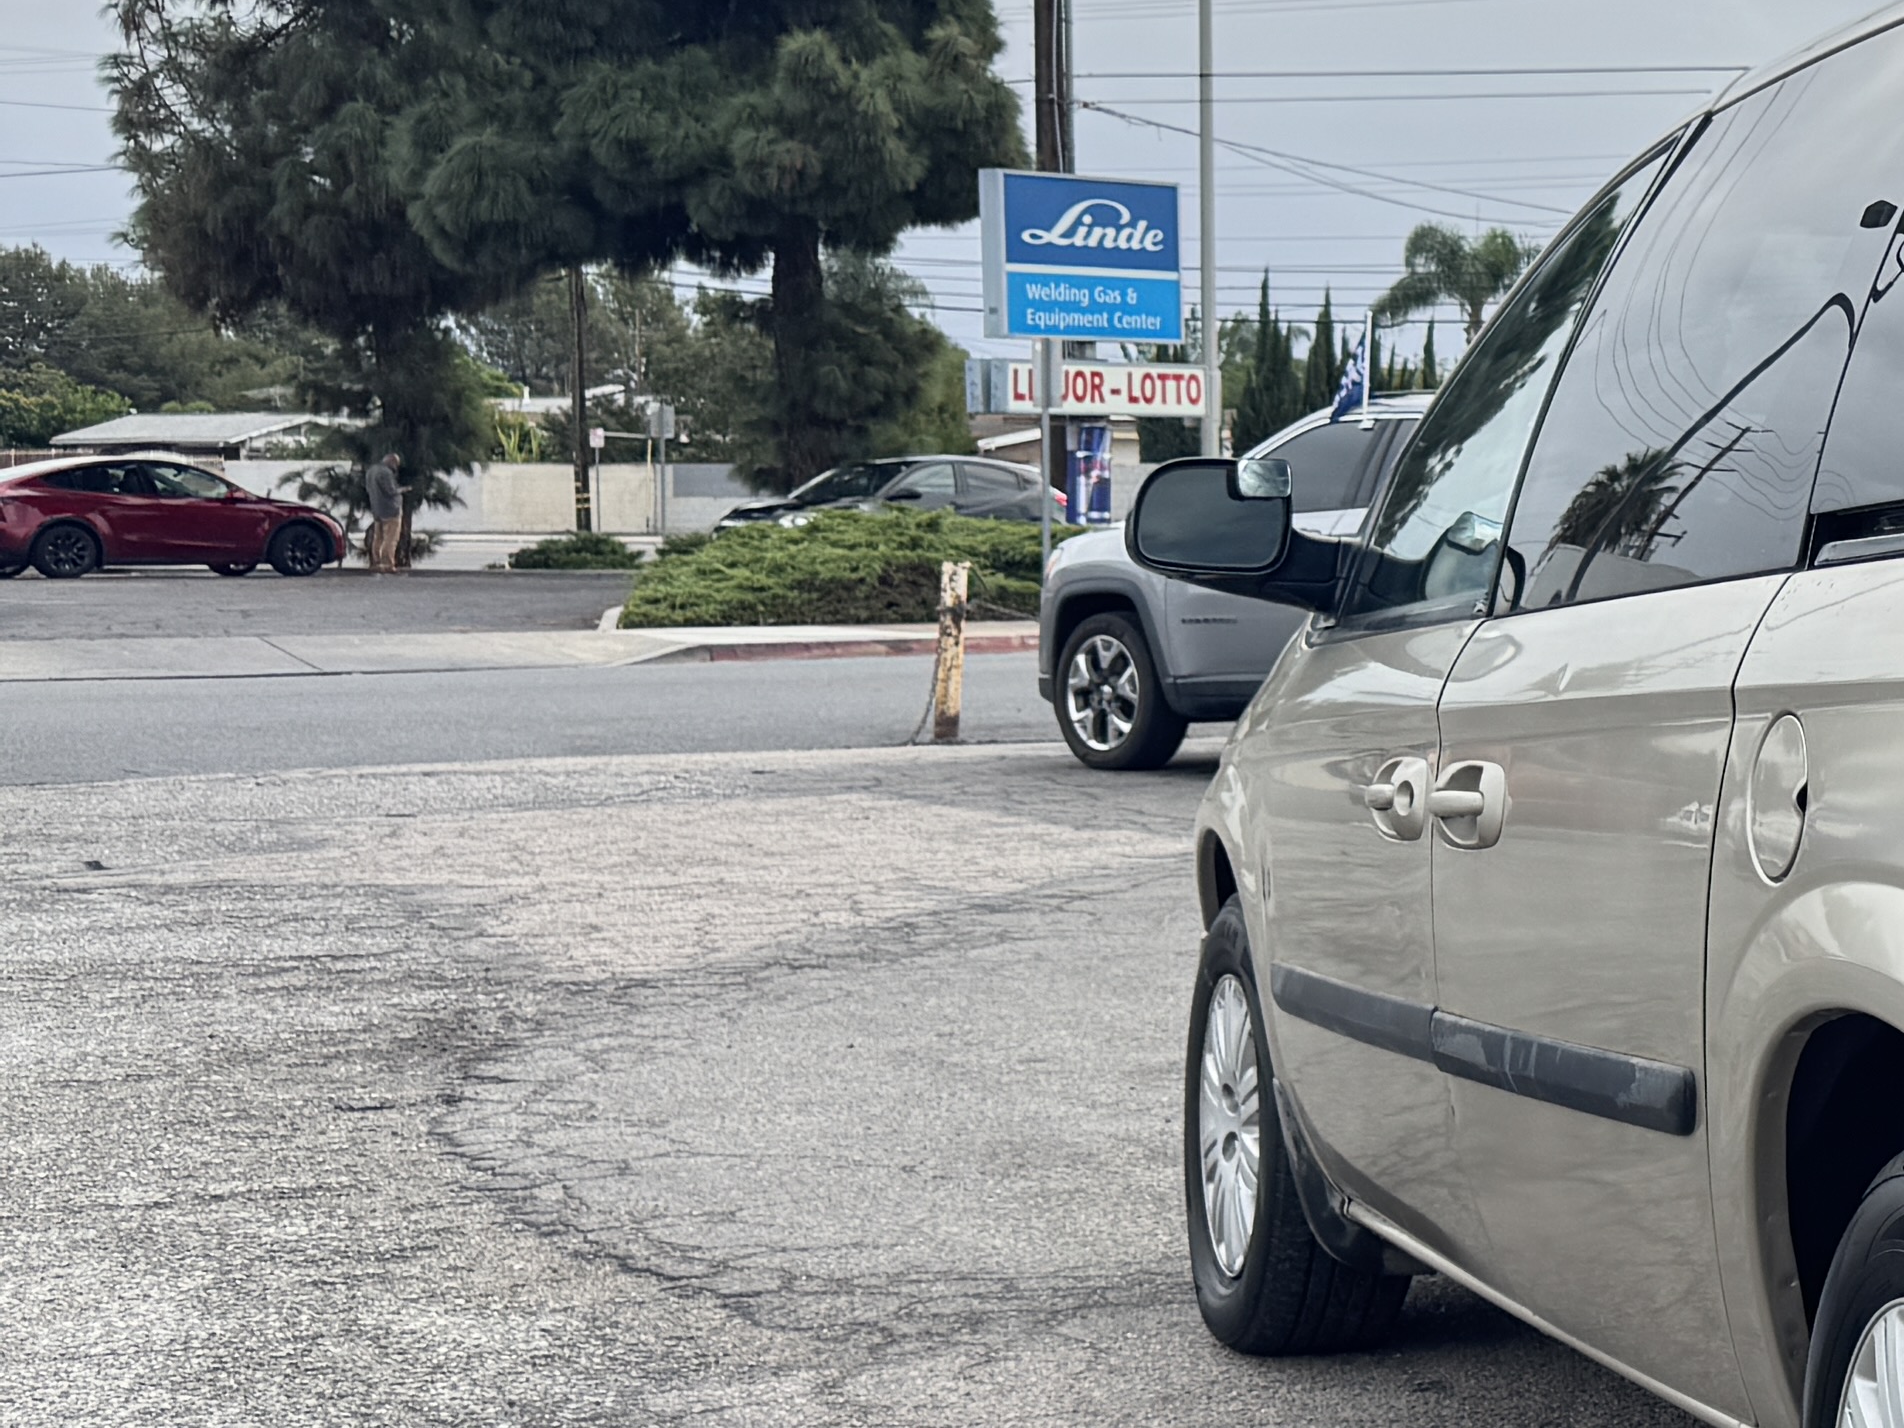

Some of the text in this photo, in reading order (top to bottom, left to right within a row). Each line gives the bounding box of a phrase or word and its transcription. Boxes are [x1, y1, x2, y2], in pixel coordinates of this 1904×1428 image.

[1021, 199, 1164, 251] Linde
[1026, 282, 1137, 307] Welding Gas &
[1026, 309, 1161, 330] Equipment Center
[1013, 368, 1105, 404] LIOR
[1127, 371, 1202, 406] LOTTO
